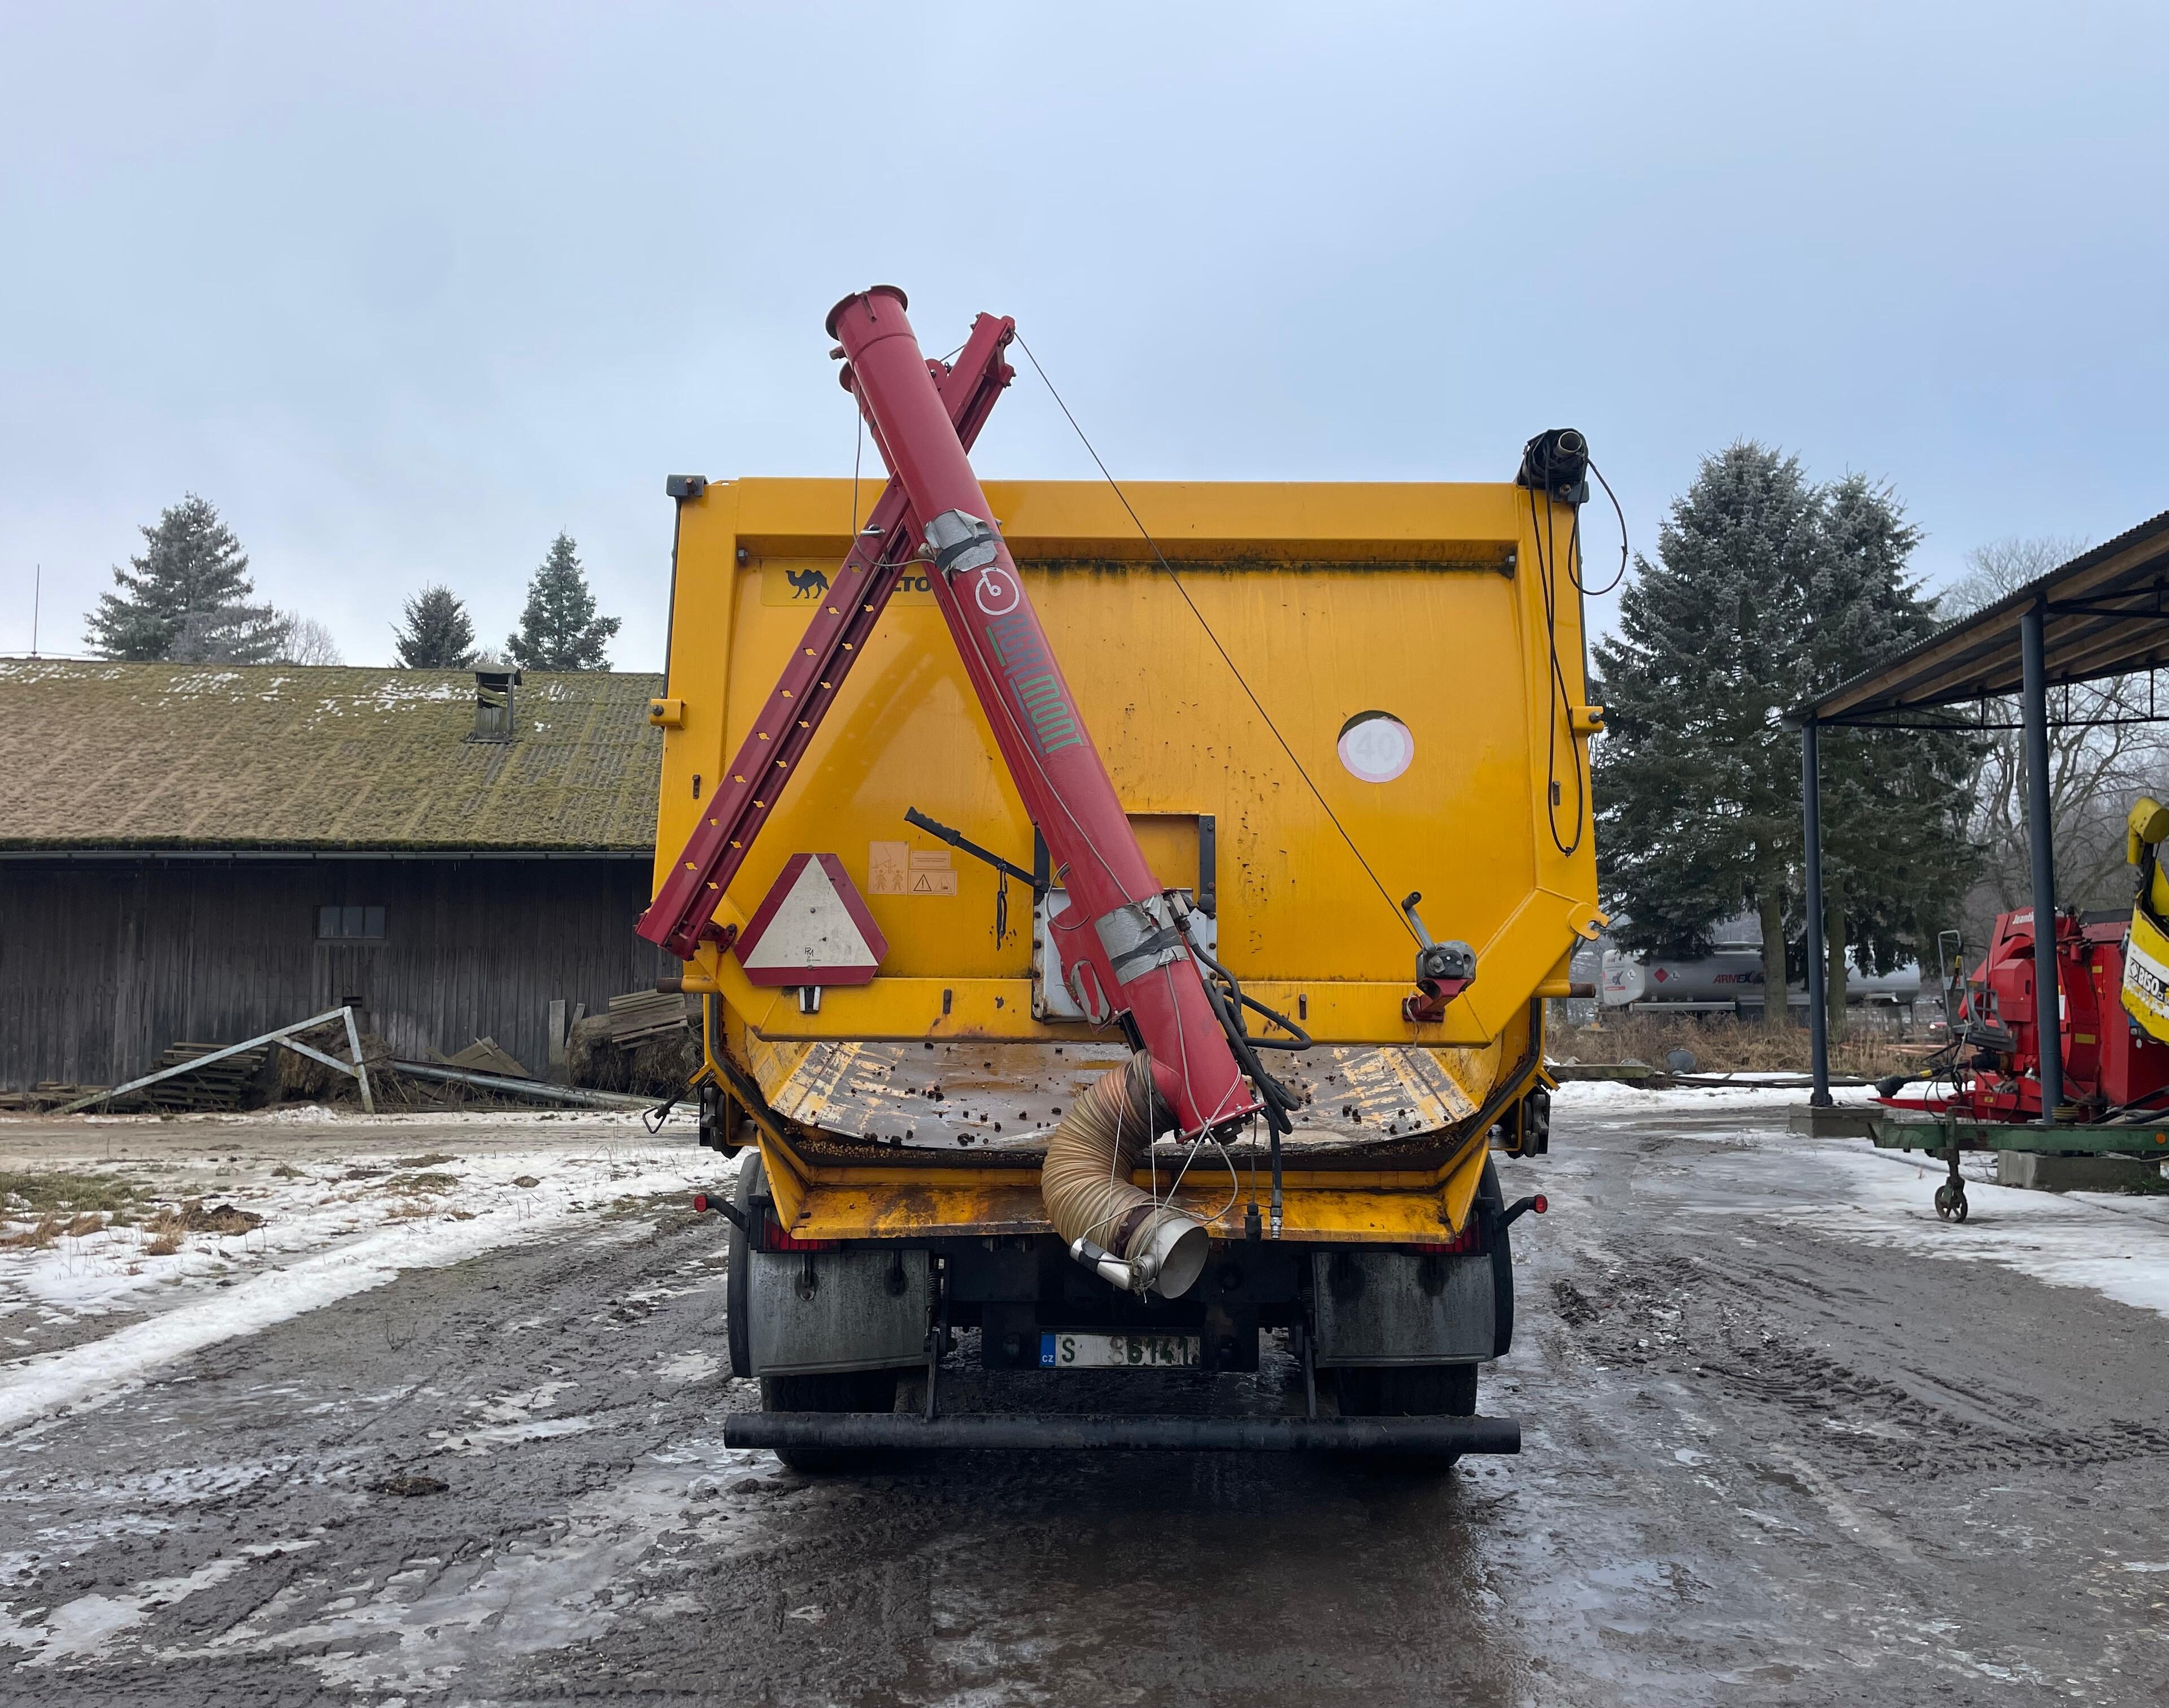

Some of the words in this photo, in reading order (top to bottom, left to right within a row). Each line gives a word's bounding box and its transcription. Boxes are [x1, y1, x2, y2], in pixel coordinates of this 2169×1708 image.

[1355, 731, 1397, 761] 40
[2137, 967, 2159, 996] BISO
[1042, 1354, 1054, 1363] CZ
